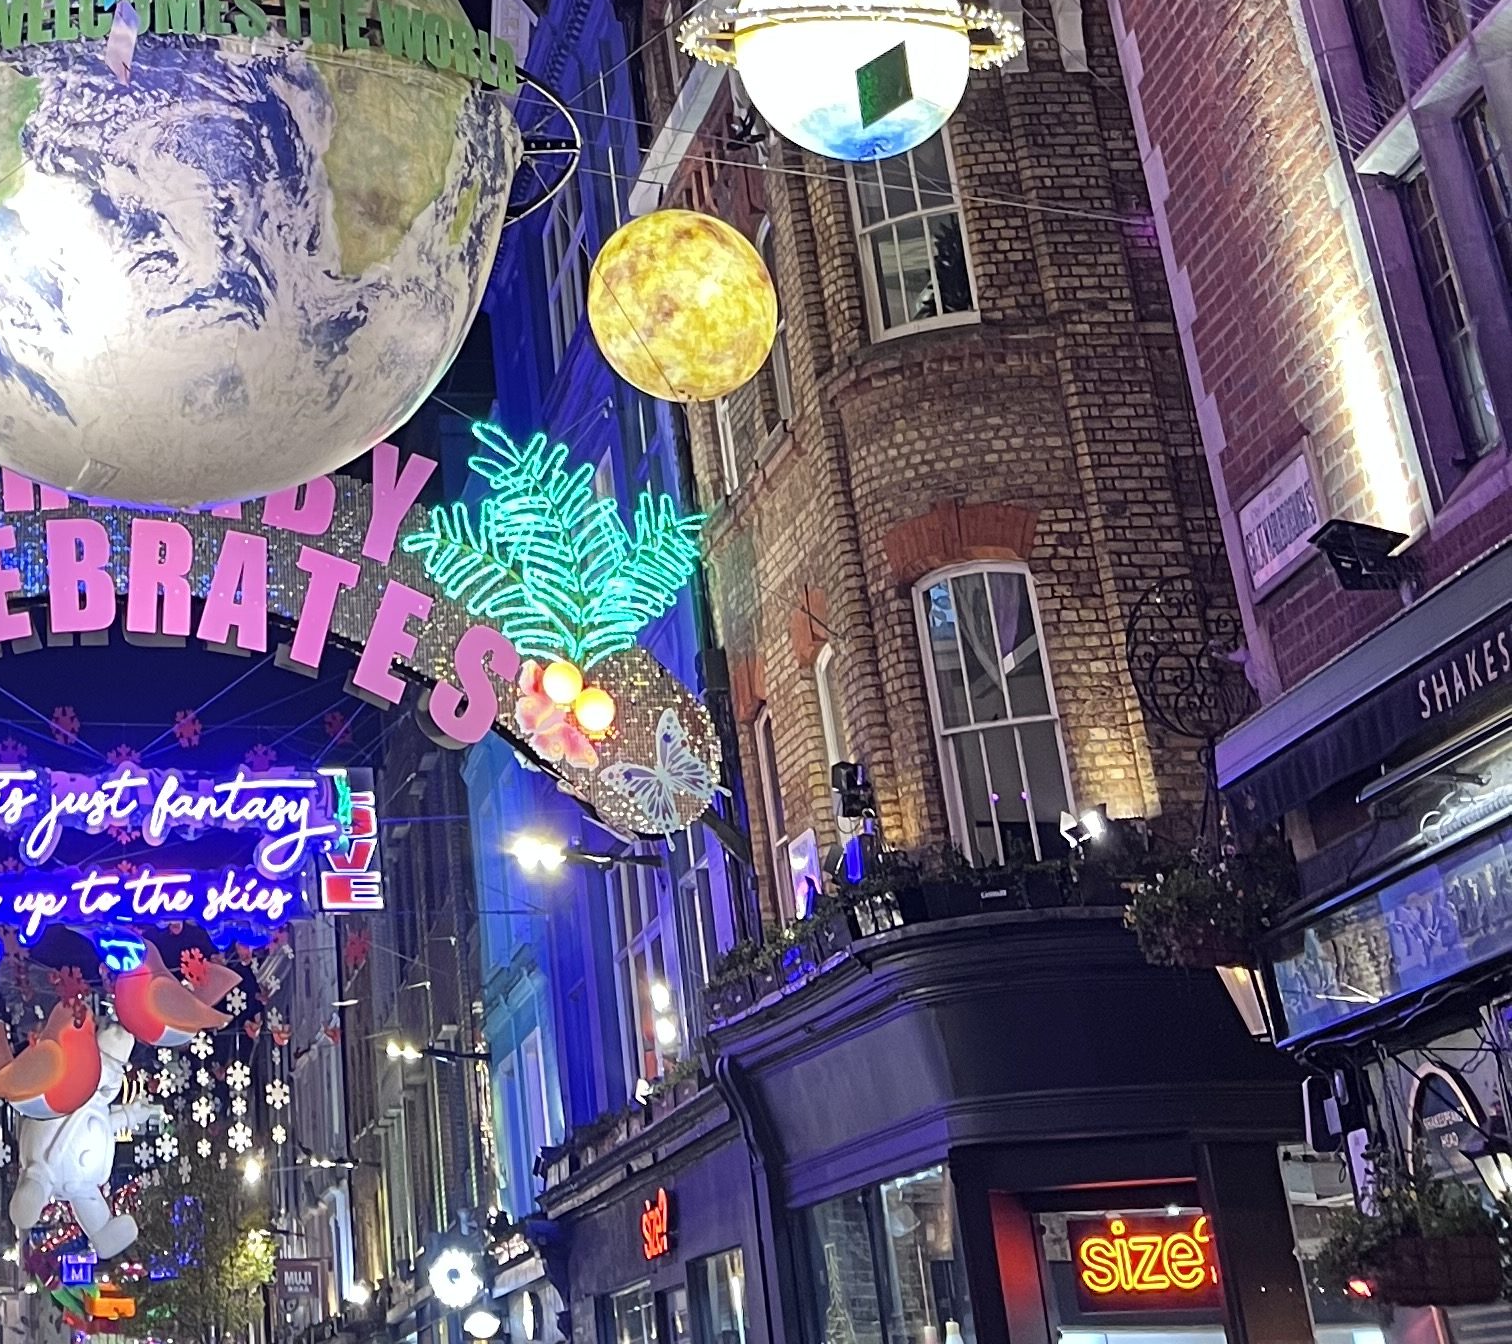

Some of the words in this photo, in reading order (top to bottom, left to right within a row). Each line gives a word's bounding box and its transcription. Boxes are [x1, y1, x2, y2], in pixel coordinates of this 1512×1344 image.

[378, 0, 518, 93] WORLD
[1418, 631, 1512, 719] SHAKES
[26, 769, 149, 859] just
[149, 771, 337, 873] fantasy
[13, 892, 68, 937] up
[71, 871, 124, 914] to
[124, 868, 194, 915] the
[201, 870, 293, 921] skies
[642, 1187, 668, 1260] size?
[284, 1271, 312, 1286] MUJI
